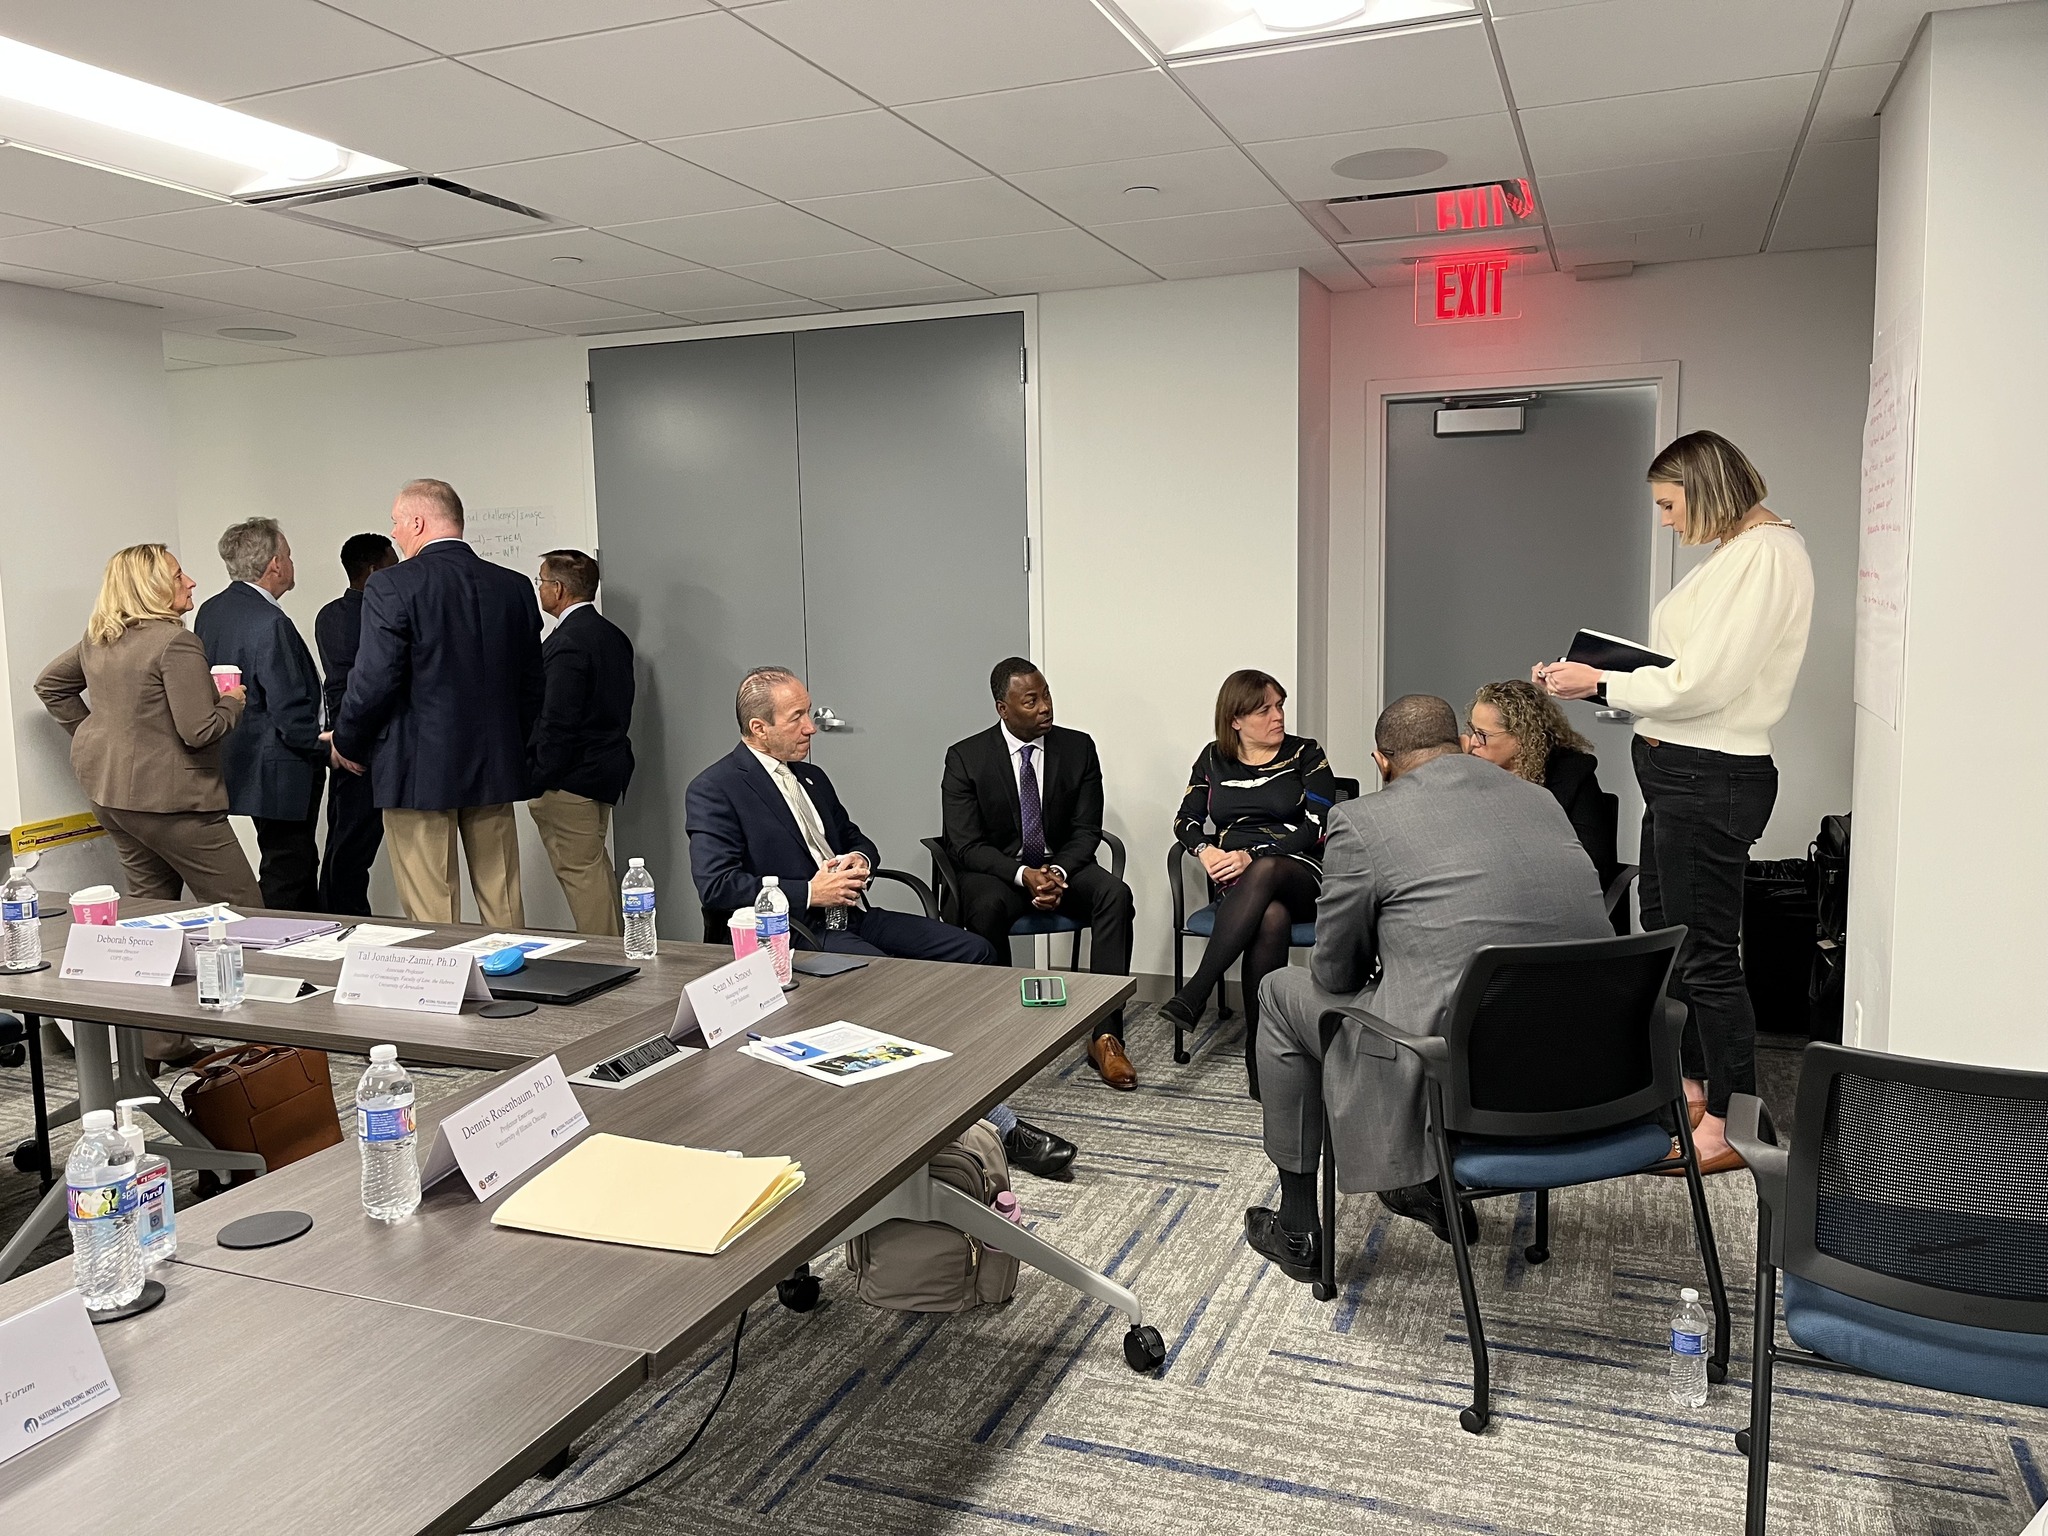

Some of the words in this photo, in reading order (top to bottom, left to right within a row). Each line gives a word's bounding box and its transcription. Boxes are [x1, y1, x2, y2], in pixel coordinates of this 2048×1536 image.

[1435, 260, 1508, 319] EXIT
[18, 838, 35, 847] Post-it
[97, 934, 127, 944] Deborah
[129, 937, 154, 947] Spence
[358, 951, 370, 961] Tal
[371, 952, 435, 966] Jonathan-Zamir,
[436, 956, 458, 968] Ph.D.
[713, 983, 728, 994] Sean
[726, 976, 736, 987] M.
[735, 969, 752, 982] Smoot
[461, 1114, 491, 1140] Dennis
[489, 1090, 536, 1122] Rosenbaum,
[5, 1382, 36, 1403] Forum
[38, 1404, 63, 1421] NATIONAL
[62, 1392, 86, 1410] POLICING
[84, 1379, 109, 1398] INSTITUTE
